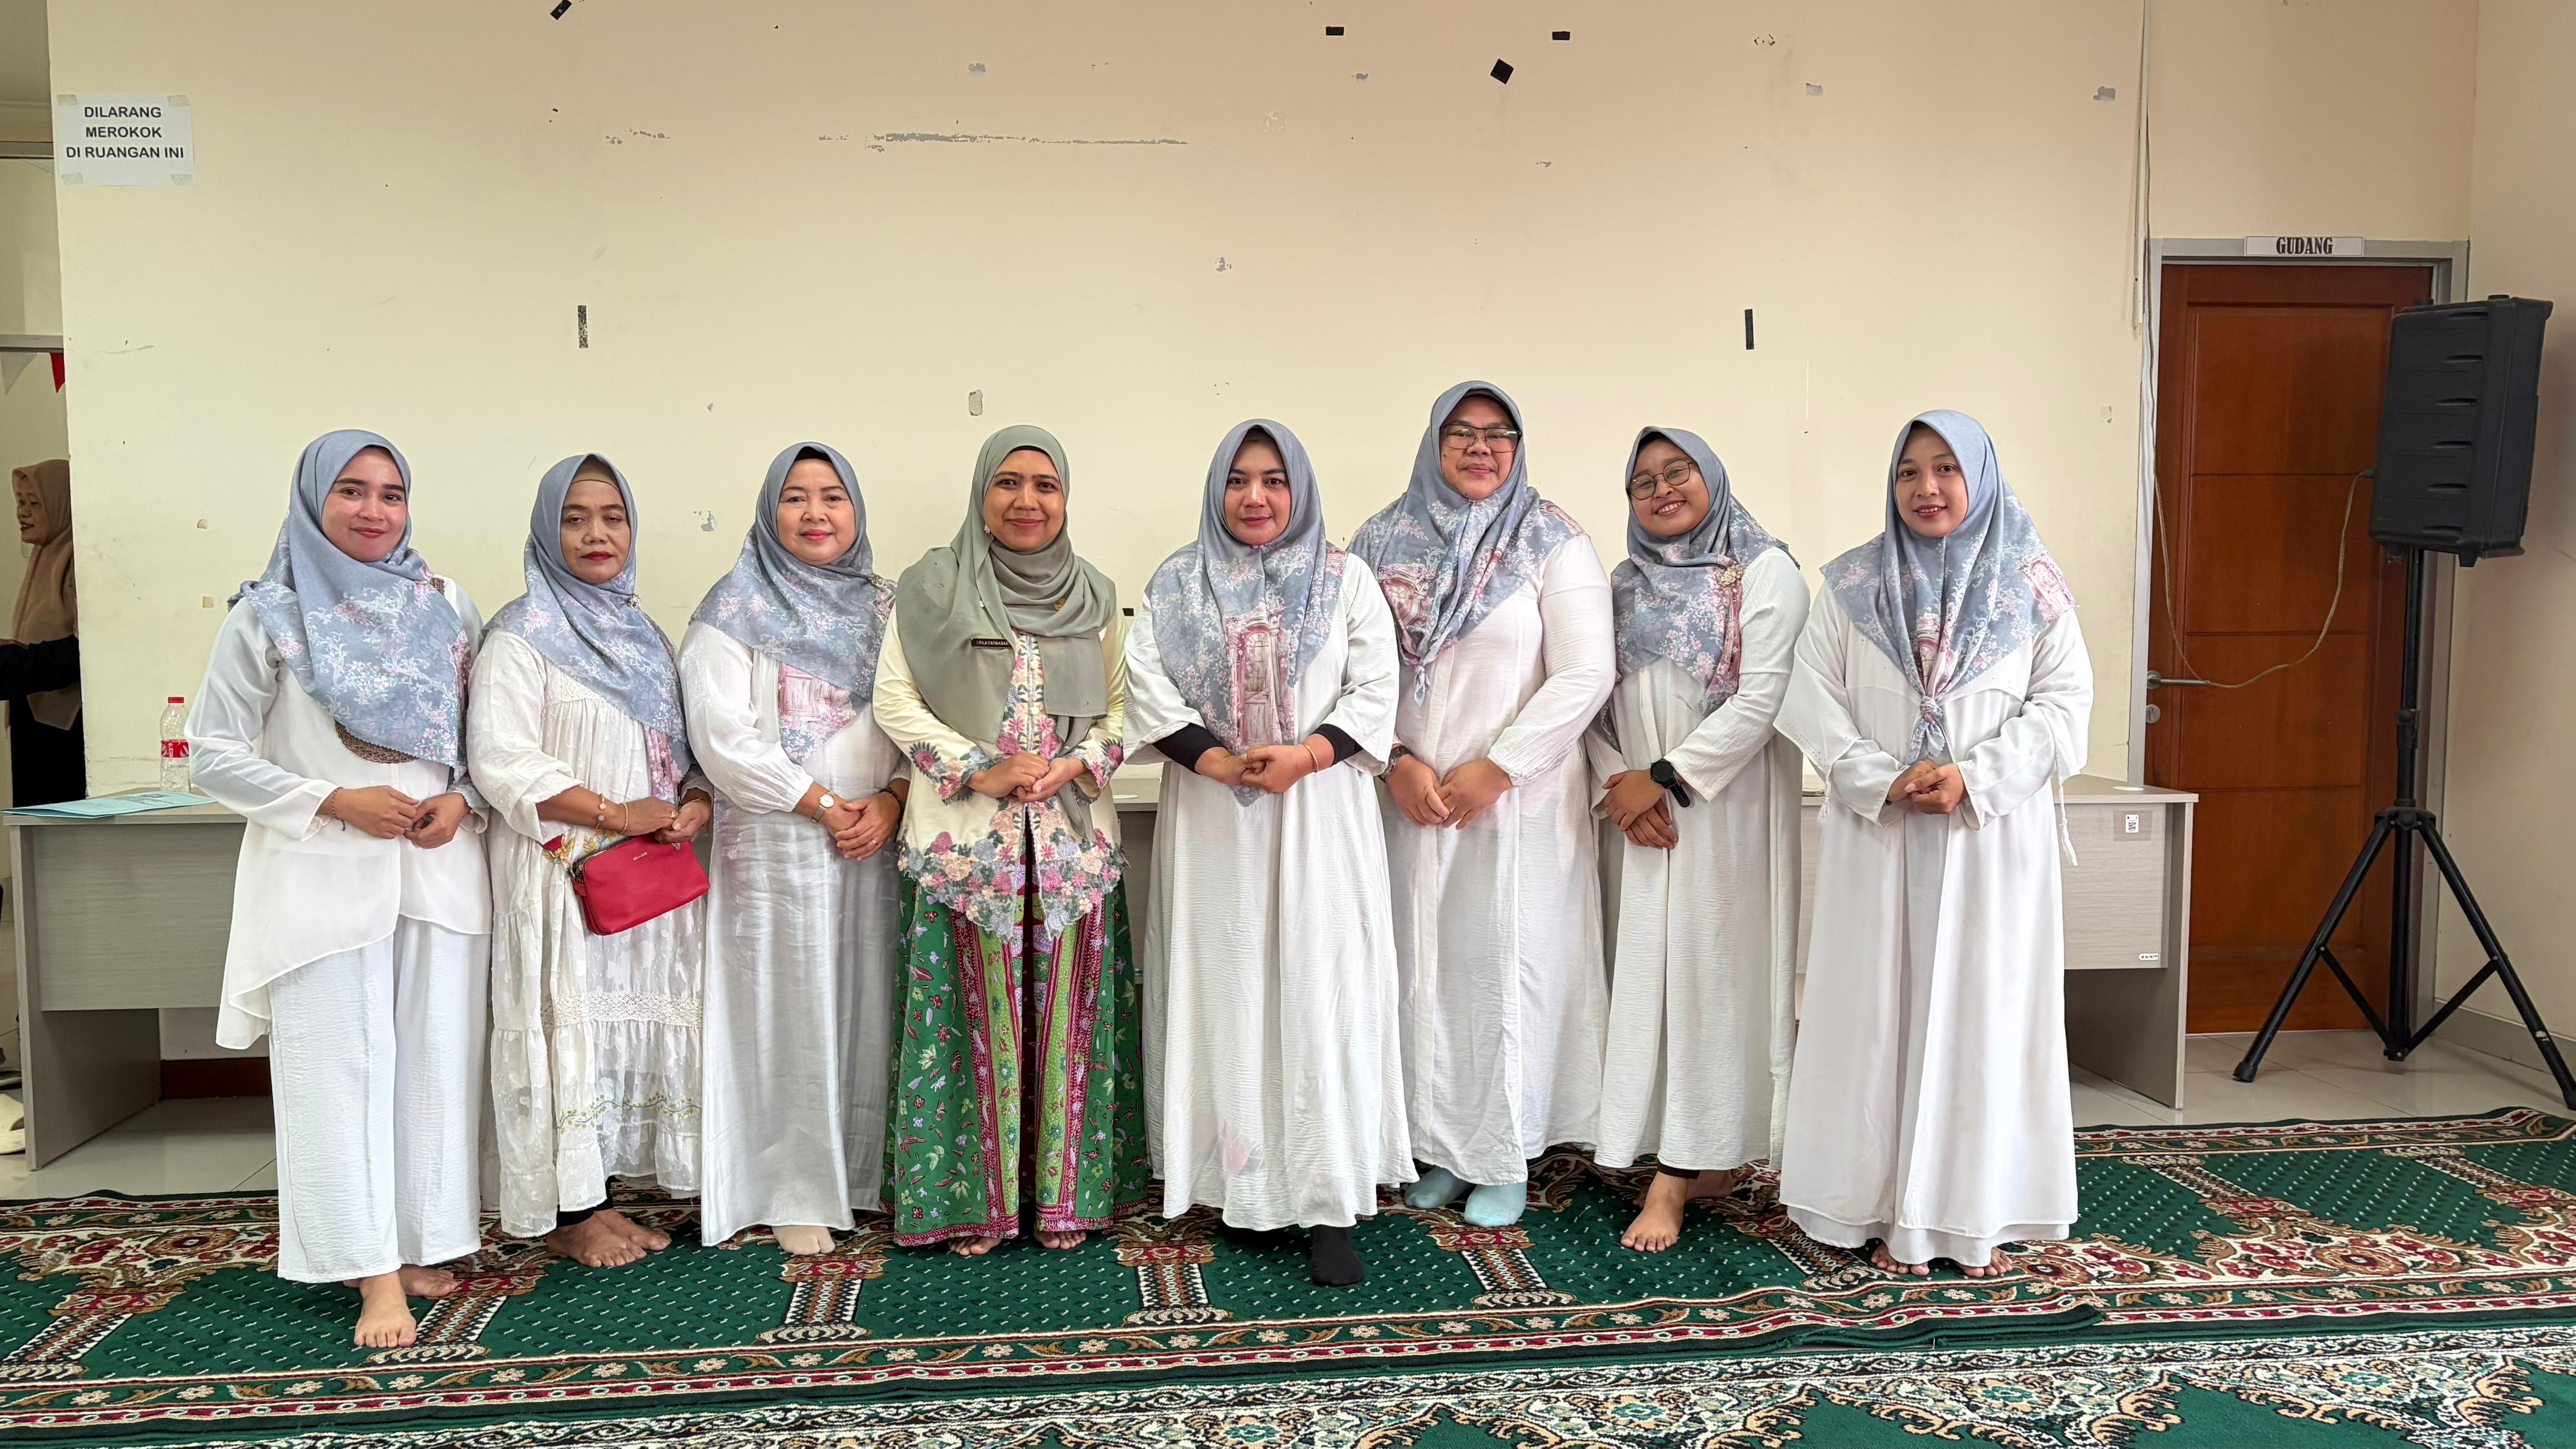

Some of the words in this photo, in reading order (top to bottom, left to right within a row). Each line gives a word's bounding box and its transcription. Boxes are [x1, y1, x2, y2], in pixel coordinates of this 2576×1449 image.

[84, 107, 162, 118] DILARANG
[85, 127, 162, 137] MEROKOK
[66, 147, 80, 158] DI
[85, 147, 160, 158] RUANGAN
[165, 147, 184, 158] INI
[2276, 237, 2333, 254] GUDANG
